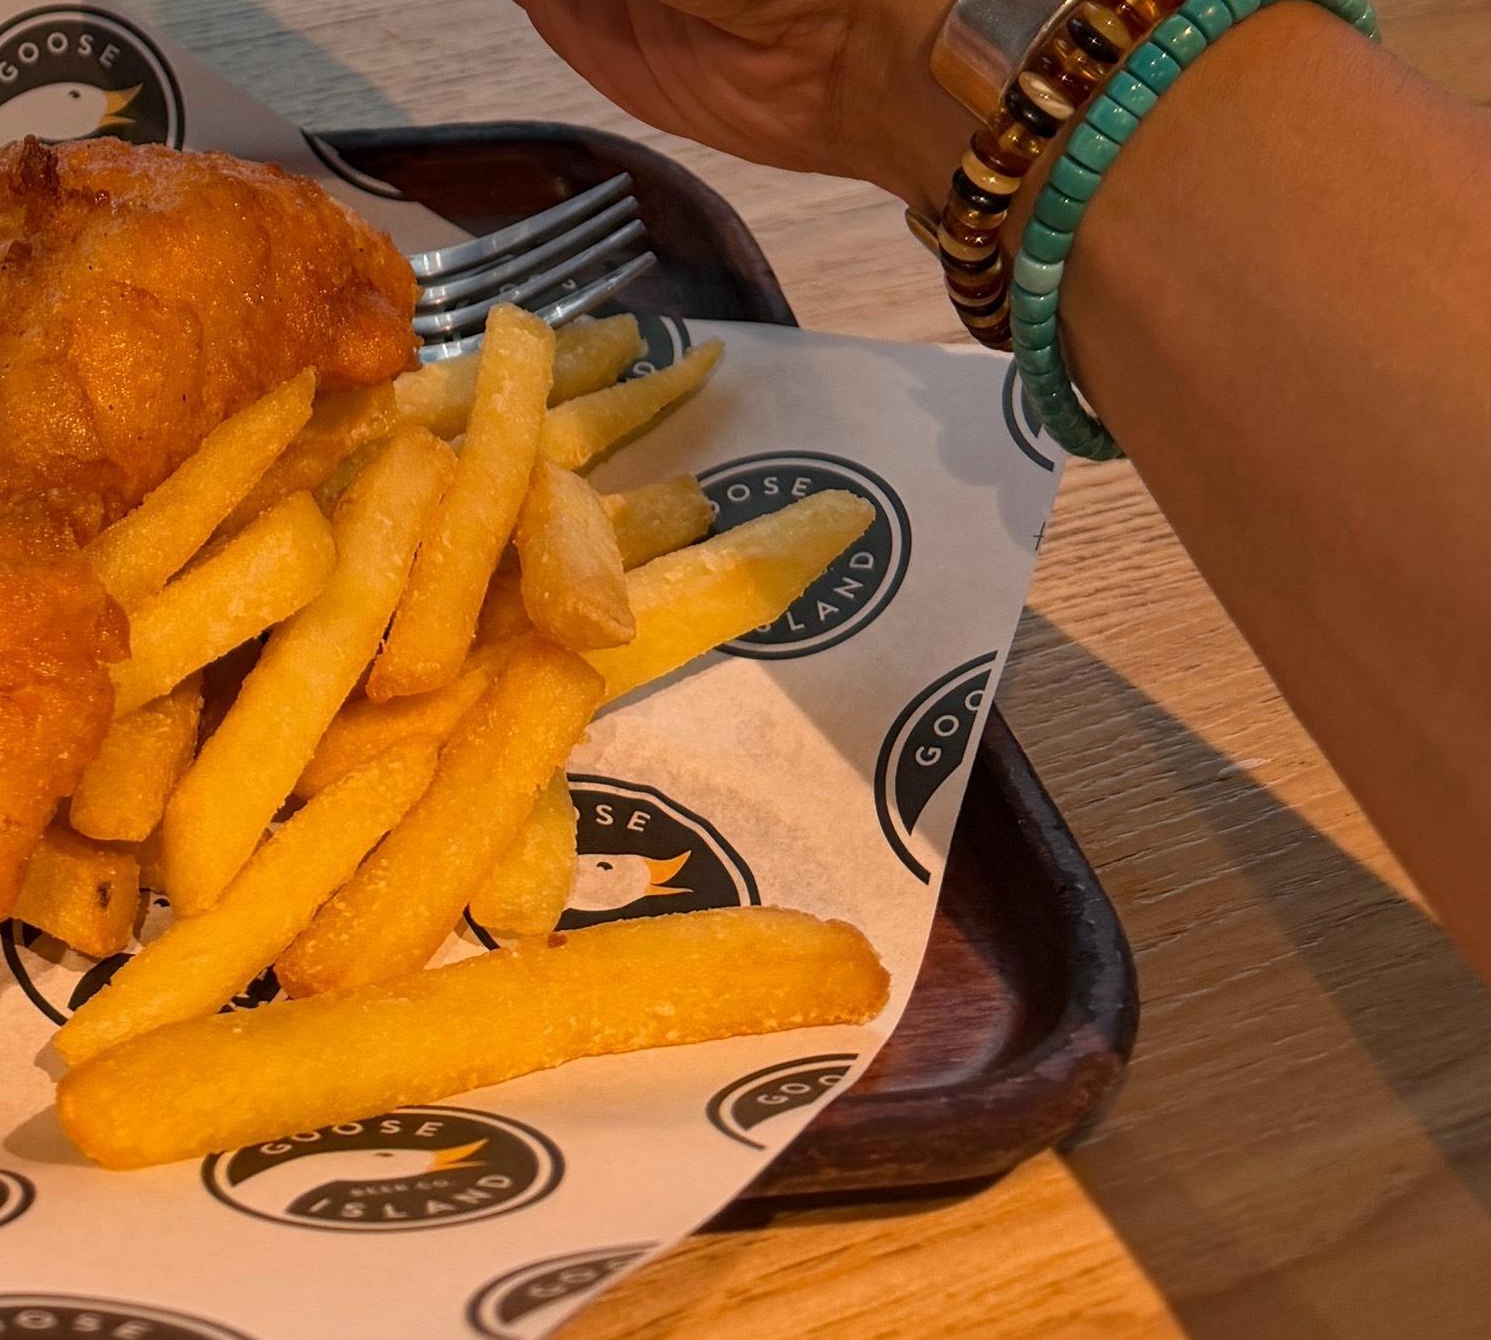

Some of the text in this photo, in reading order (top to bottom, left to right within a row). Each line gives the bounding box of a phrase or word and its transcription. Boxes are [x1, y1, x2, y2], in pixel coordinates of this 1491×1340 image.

[712, 476, 812, 513] OSE
[756, 551, 875, 633] LAND
[915, 689, 986, 767] GOO
[756, 1074, 844, 1105] GOO
[260, 1120, 443, 1156] GOOSE
[310, 1174, 512, 1218] ISLAND
